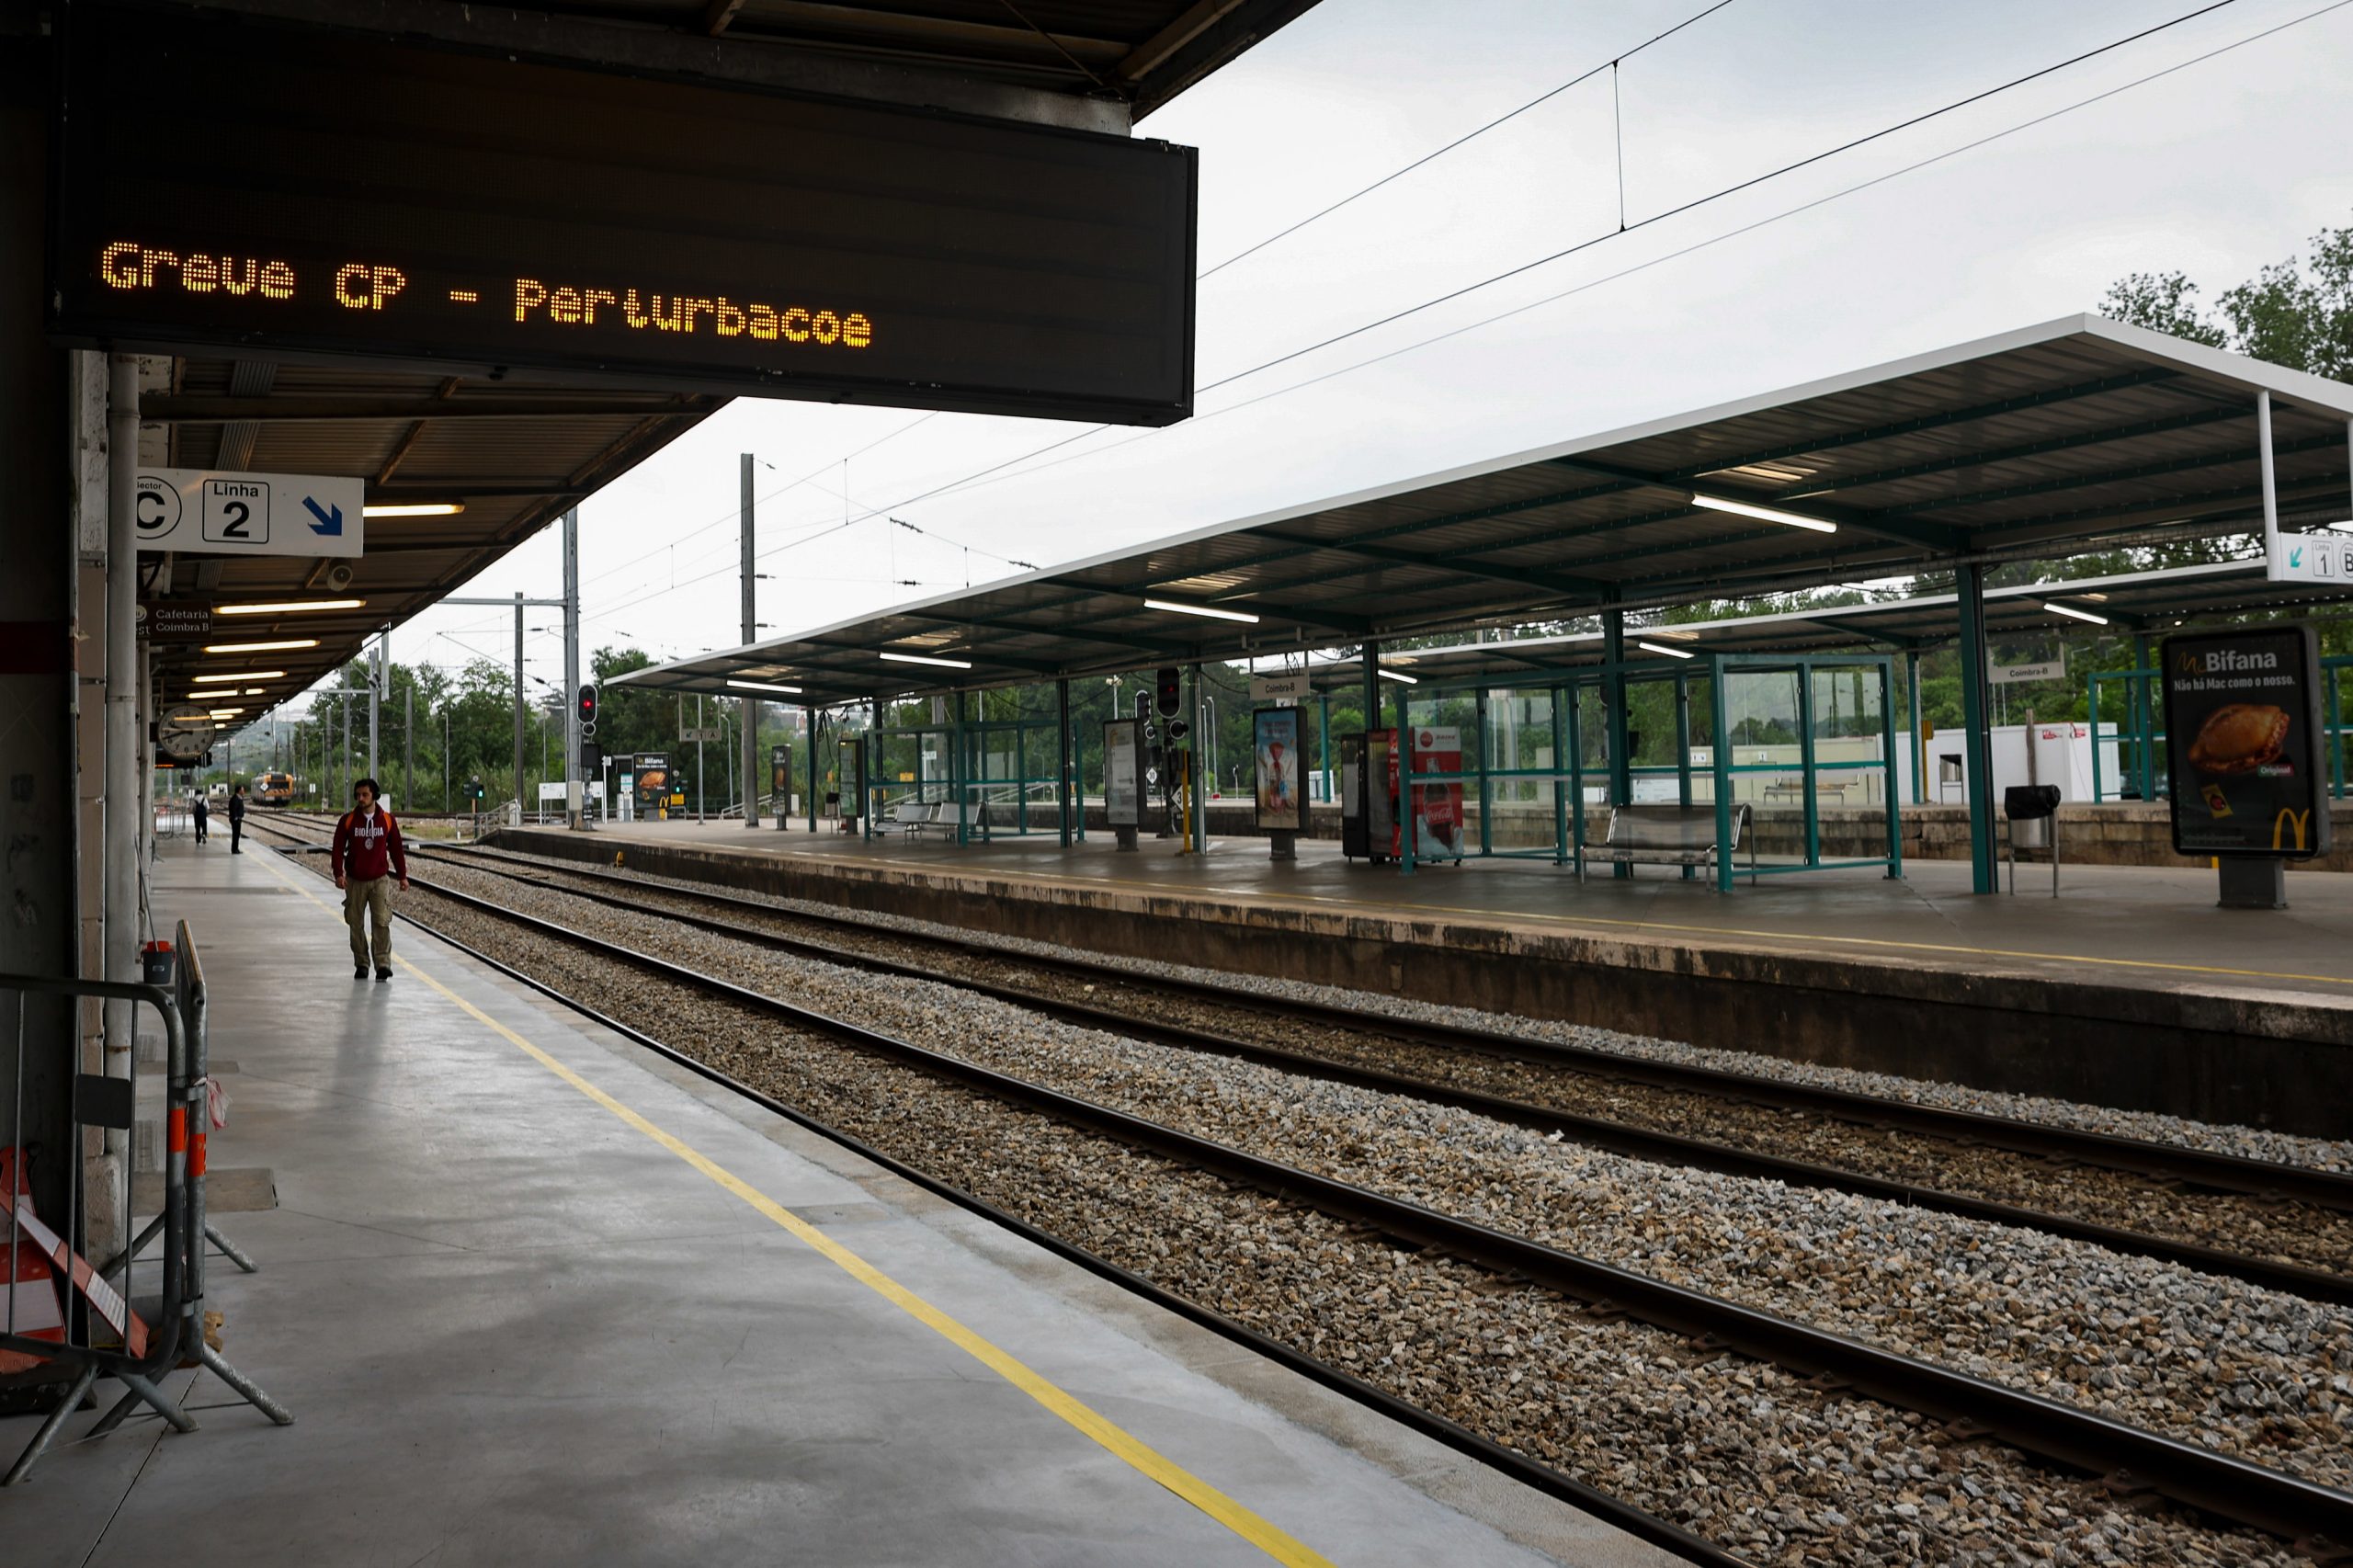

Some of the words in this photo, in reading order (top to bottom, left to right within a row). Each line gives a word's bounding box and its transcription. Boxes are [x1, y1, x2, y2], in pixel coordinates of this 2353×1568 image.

[102, 242, 294, 300] Greve
[335, 263, 406, 310] CP
[449, 290, 477, 302] -
[516, 278, 871, 347] Perturbacoe
[137, 482, 162, 490] ector
[213, 483, 259, 497] Linha
[137, 491, 165, 529] C
[222, 501, 249, 538] 2
[2320, 553, 2327, 574] 1
[155, 608, 209, 619] Cafetaria
[155, 622, 200, 632] Coimbra
[202, 622, 210, 631] B
[2009, 667, 2048, 677] Coimbra-B
[1265, 682, 1295, 693] Coimbra-B
[2174, 678, 2192, 691] Não
[2193, 676, 2205, 690] há
[2206, 677, 2226, 689] Mac
[2227, 677, 2254, 688] como
[2255, 676, 2262, 687] o
[2263, 675, 2295, 687] nosso.
[2260, 765, 2291, 776] Original
[354, 826, 384, 837] BIOLOGIA
